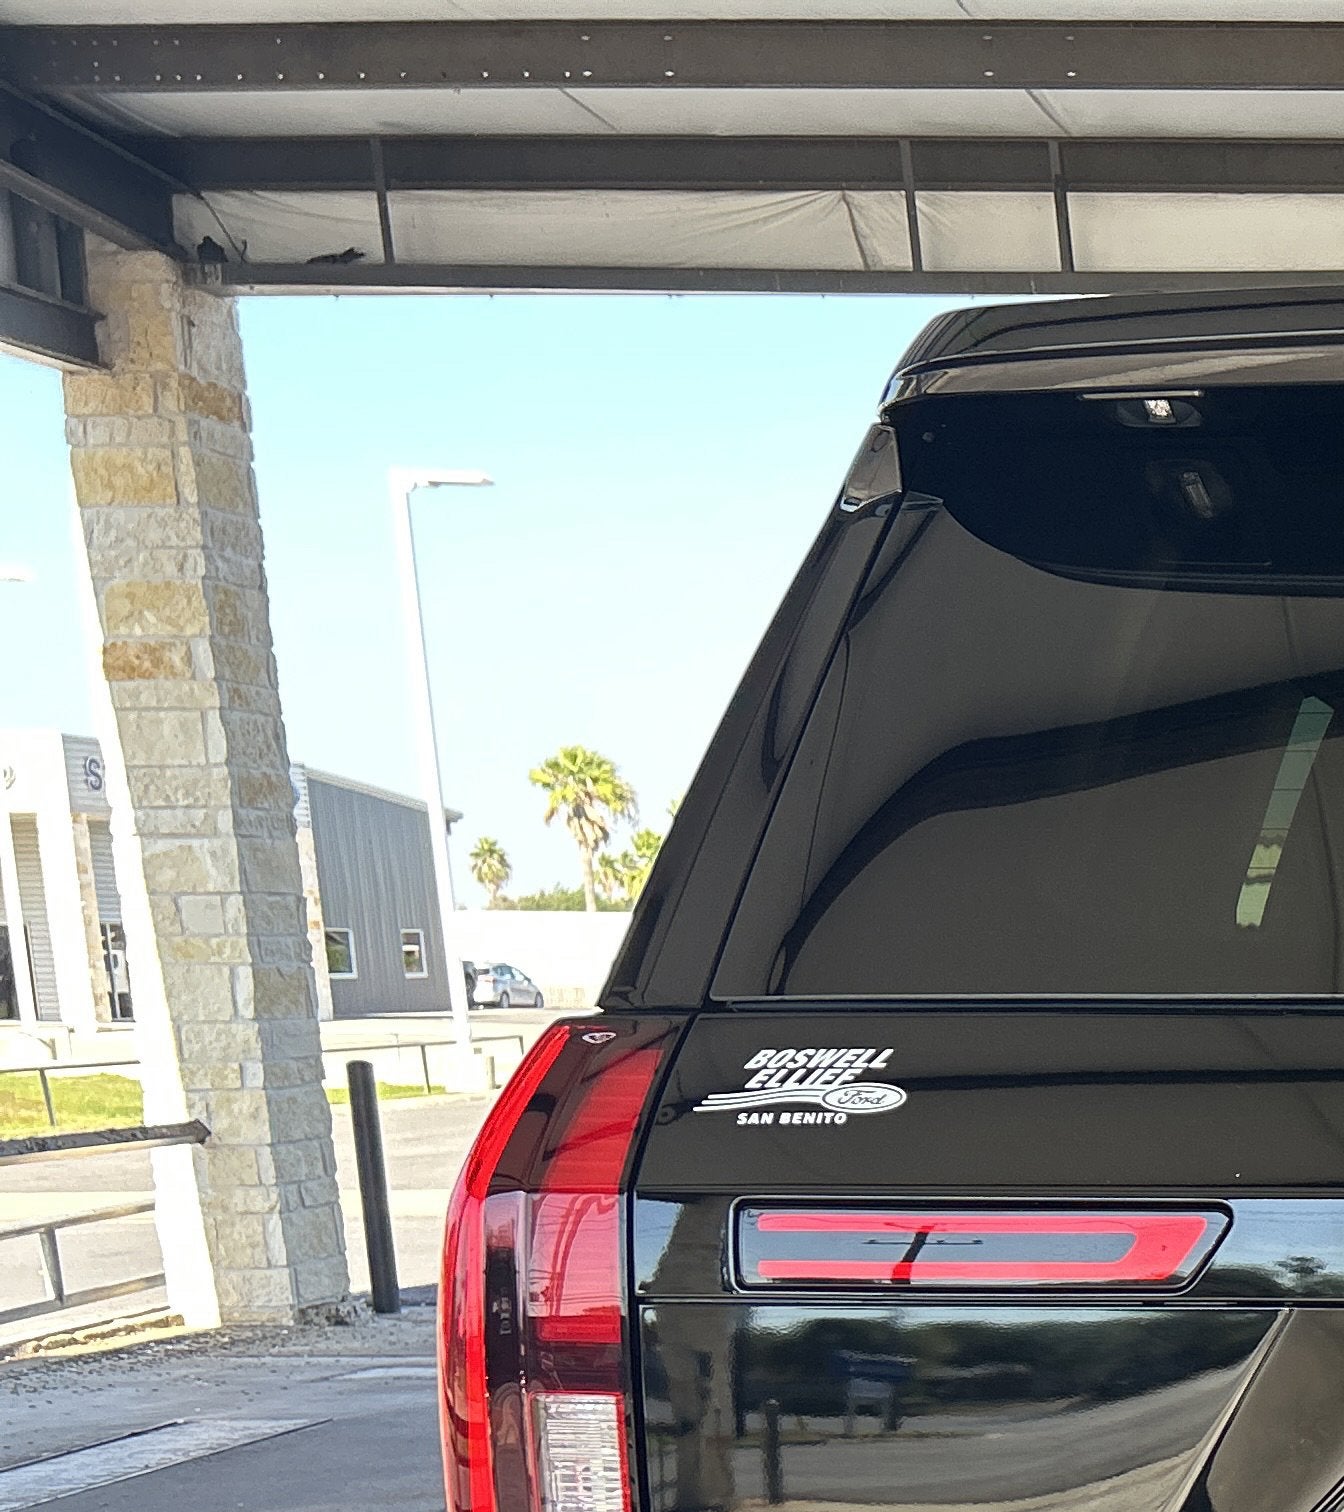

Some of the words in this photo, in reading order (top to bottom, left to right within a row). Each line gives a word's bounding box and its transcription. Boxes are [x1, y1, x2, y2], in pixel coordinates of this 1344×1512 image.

[744, 1049, 894, 1069] BOSWELL
[838, 1089, 888, 1105] Ford
[736, 1112, 774, 1125] SAN
[778, 1112, 848, 1125] BENITO
